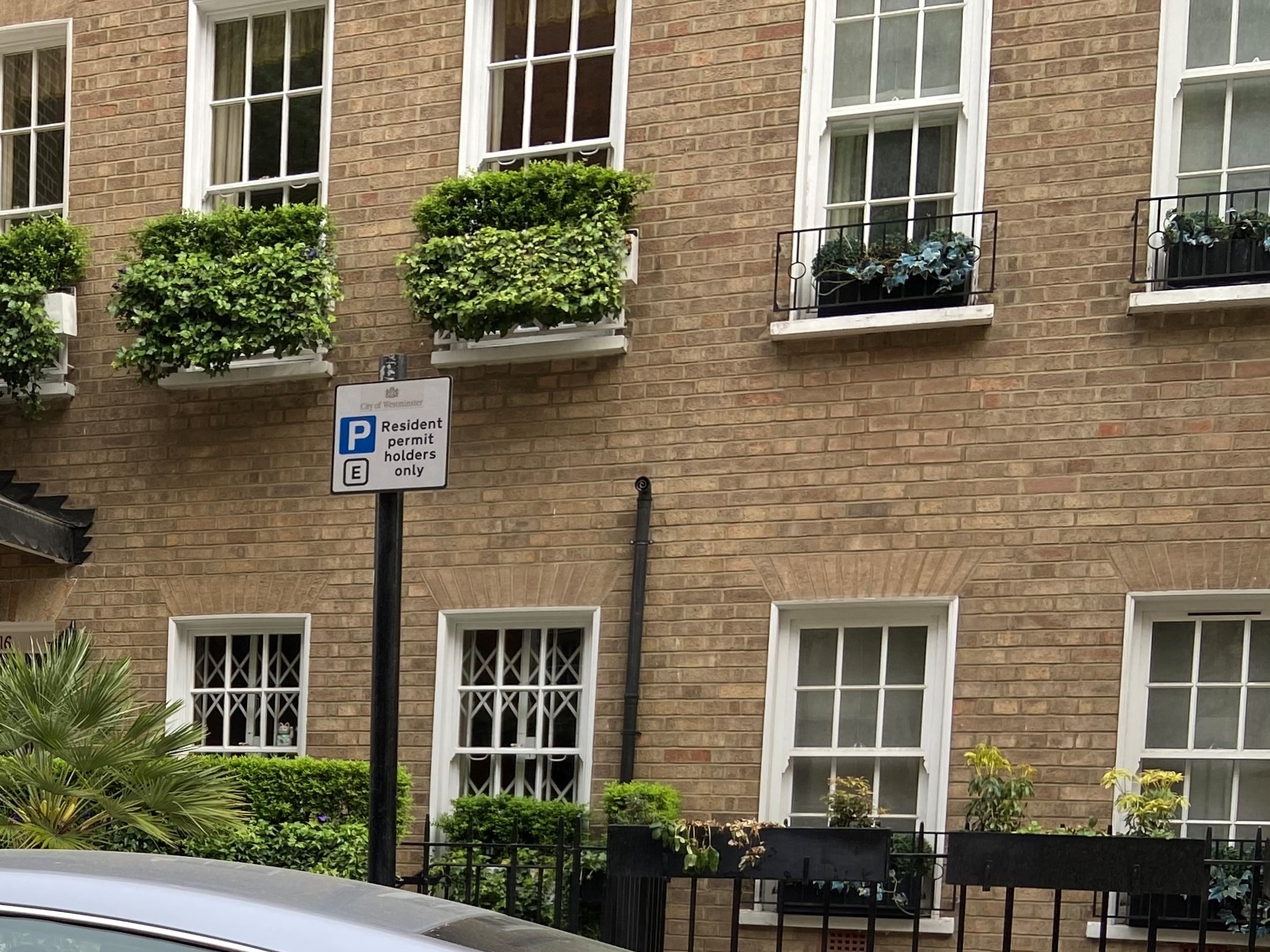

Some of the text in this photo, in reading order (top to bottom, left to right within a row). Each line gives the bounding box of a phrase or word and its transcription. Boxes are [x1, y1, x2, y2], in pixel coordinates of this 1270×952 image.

[360, 399, 423, 411] City of Westminster
[381, 417, 443, 433] Resident
[348, 420, 371, 451] P
[387, 433, 434, 449] permit
[384, 450, 437, 462] holders
[351, 465, 361, 480] E
[394, 464, 424, 478] only
[0, 635, 12, 650] 16
